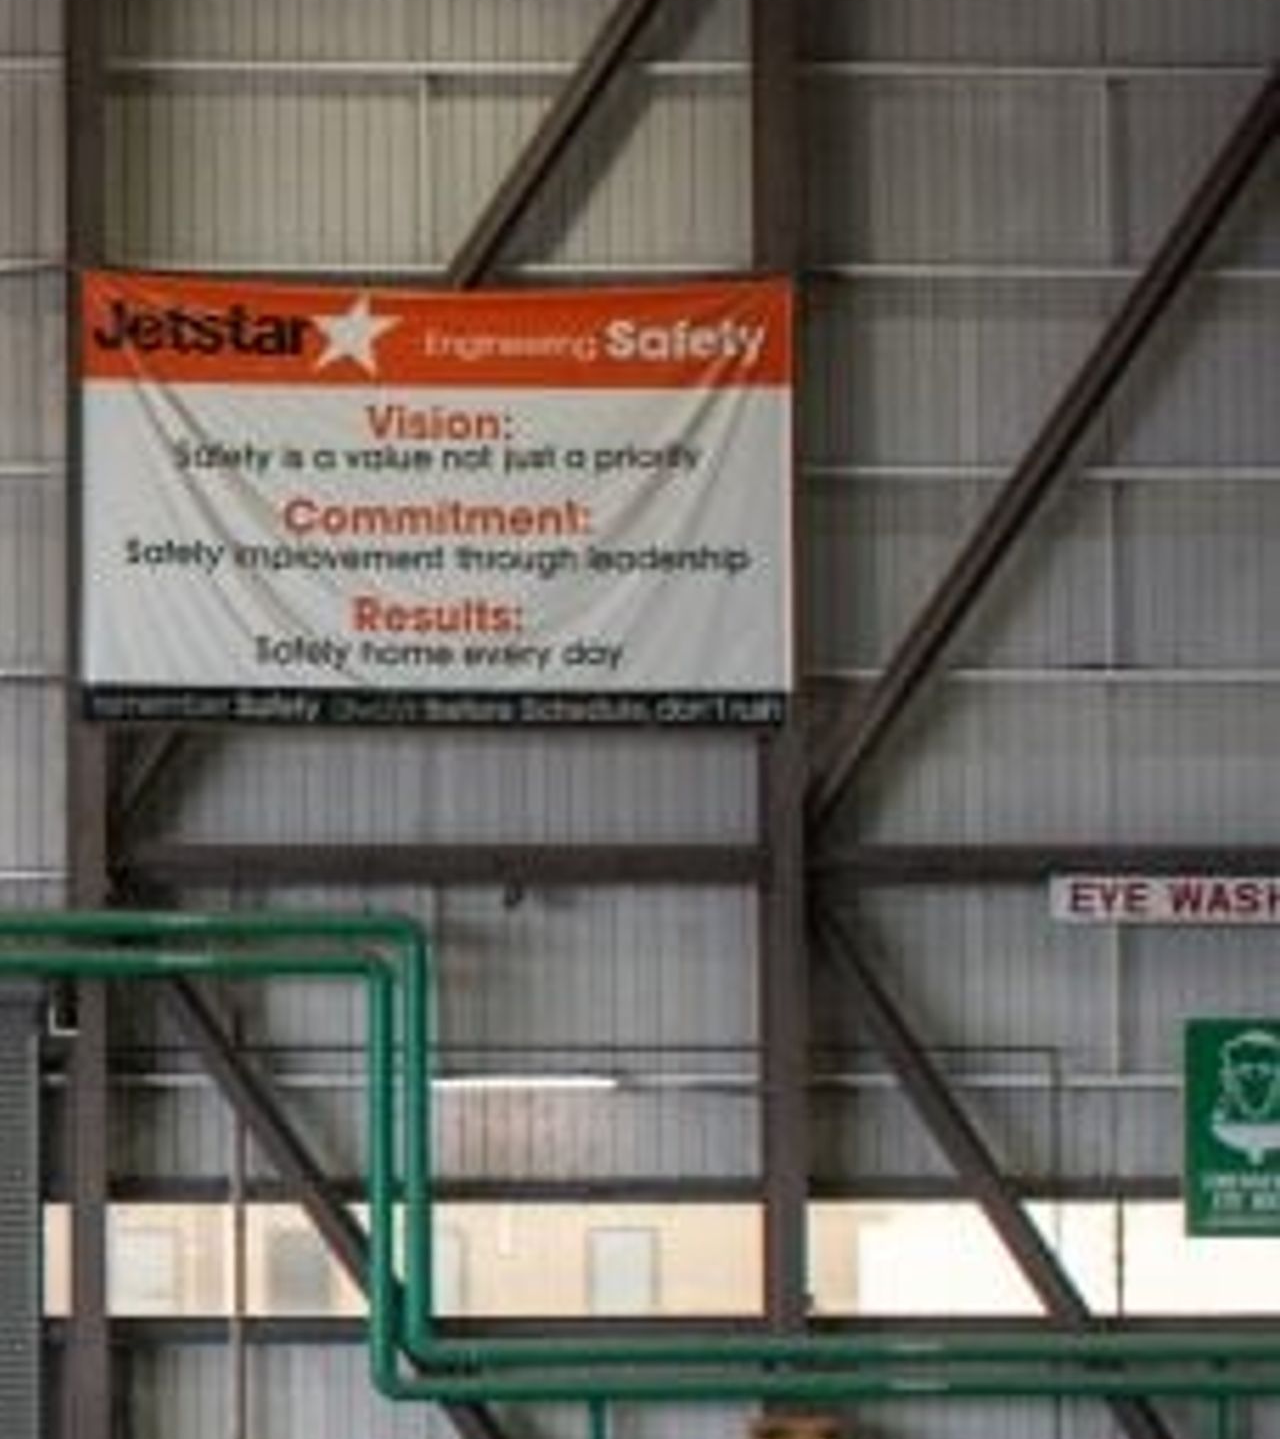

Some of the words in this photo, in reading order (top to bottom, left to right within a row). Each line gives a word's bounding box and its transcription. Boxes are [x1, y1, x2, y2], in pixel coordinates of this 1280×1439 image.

[93, 299, 312, 356] Jetstar
[604, 319, 765, 366] Safety
[365, 404, 514, 441] Vision:
[175, 439, 274, 473] Safety
[282, 445, 303, 469] is
[312, 450, 337, 469] a
[344, 445, 433, 469] value
[442, 446, 495, 469] not
[504, 444, 557, 473] just
[564, 447, 587, 469] a
[594, 442, 701, 474] priority
[282, 498, 591, 537] Commitment:
[126, 539, 224, 574] Safety
[455, 546, 578, 579] through
[352, 595, 524, 634] Results:
[253, 635, 351, 669] Safety
[360, 640, 455, 666] home
[464, 644, 551, 671] every
[560, 637, 625, 670] day
[1067, 881, 1148, 914] EYE
